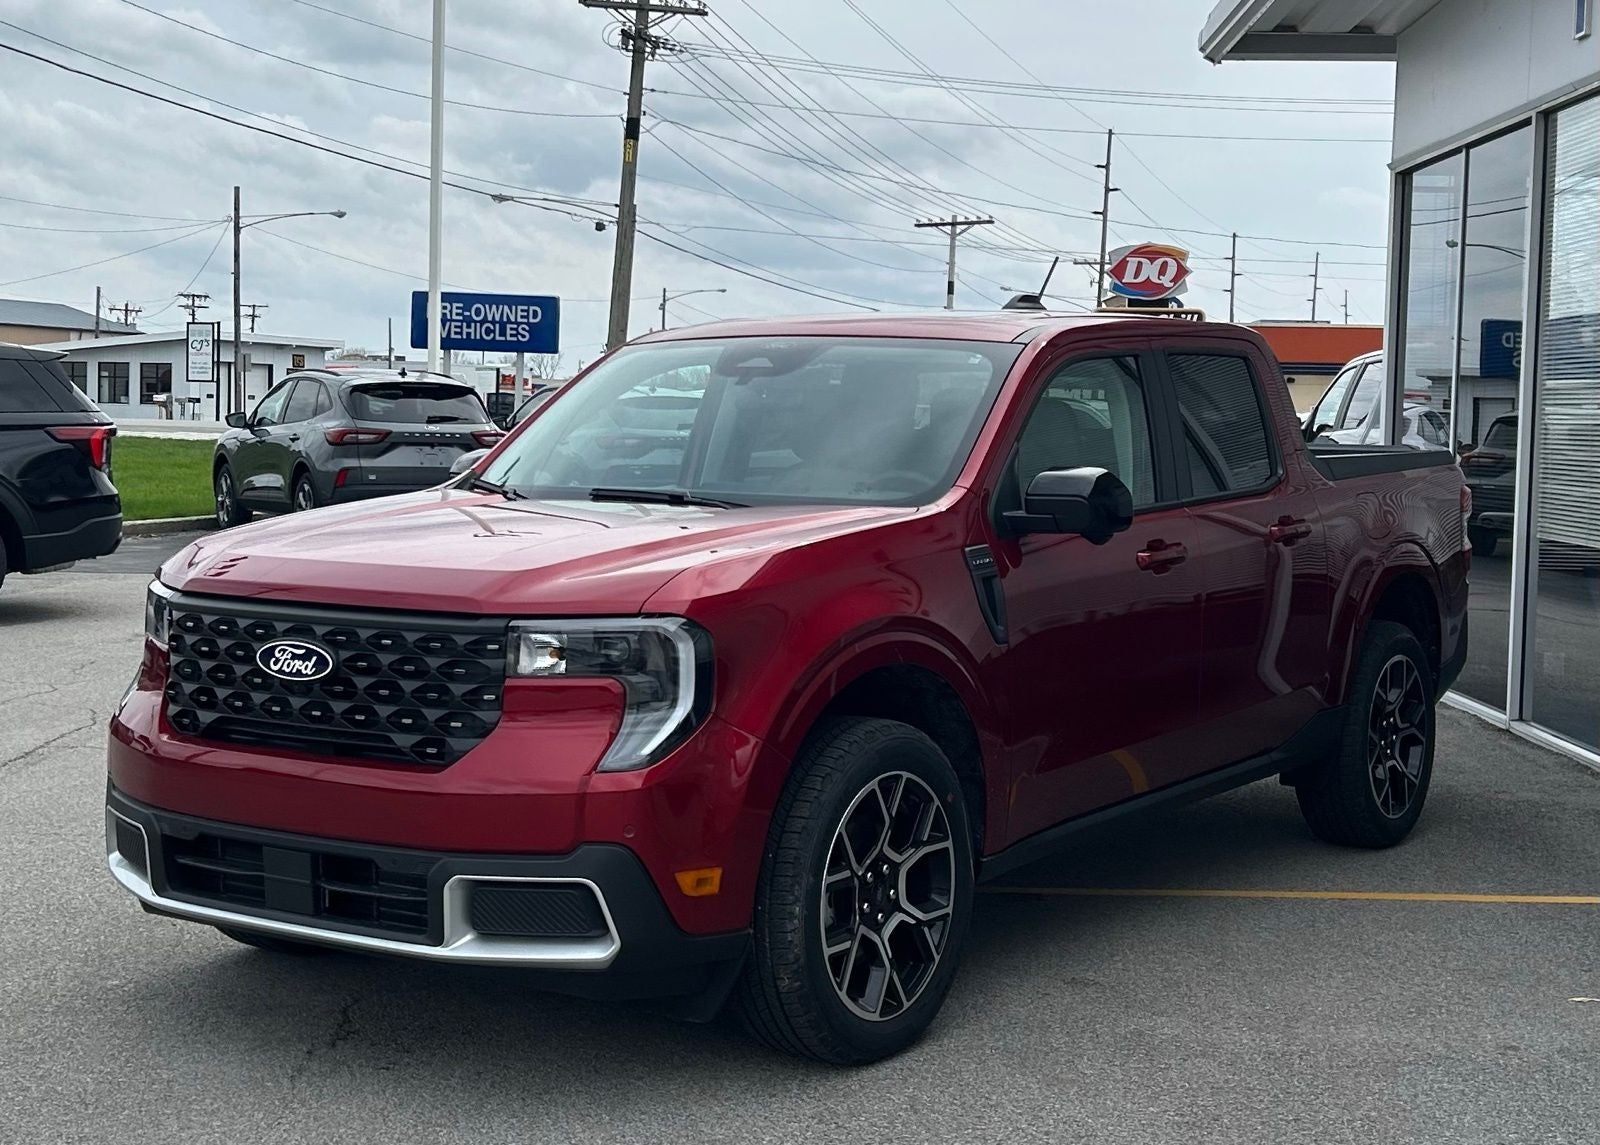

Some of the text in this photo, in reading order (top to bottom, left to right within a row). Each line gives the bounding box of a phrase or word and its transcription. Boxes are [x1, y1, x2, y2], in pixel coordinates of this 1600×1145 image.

[1122, 257, 1178, 288] DQ
[440, 302, 542, 323] RE-OWNED
[440, 321, 530, 342] VEHICLES
[269, 645, 317, 675] Ford
